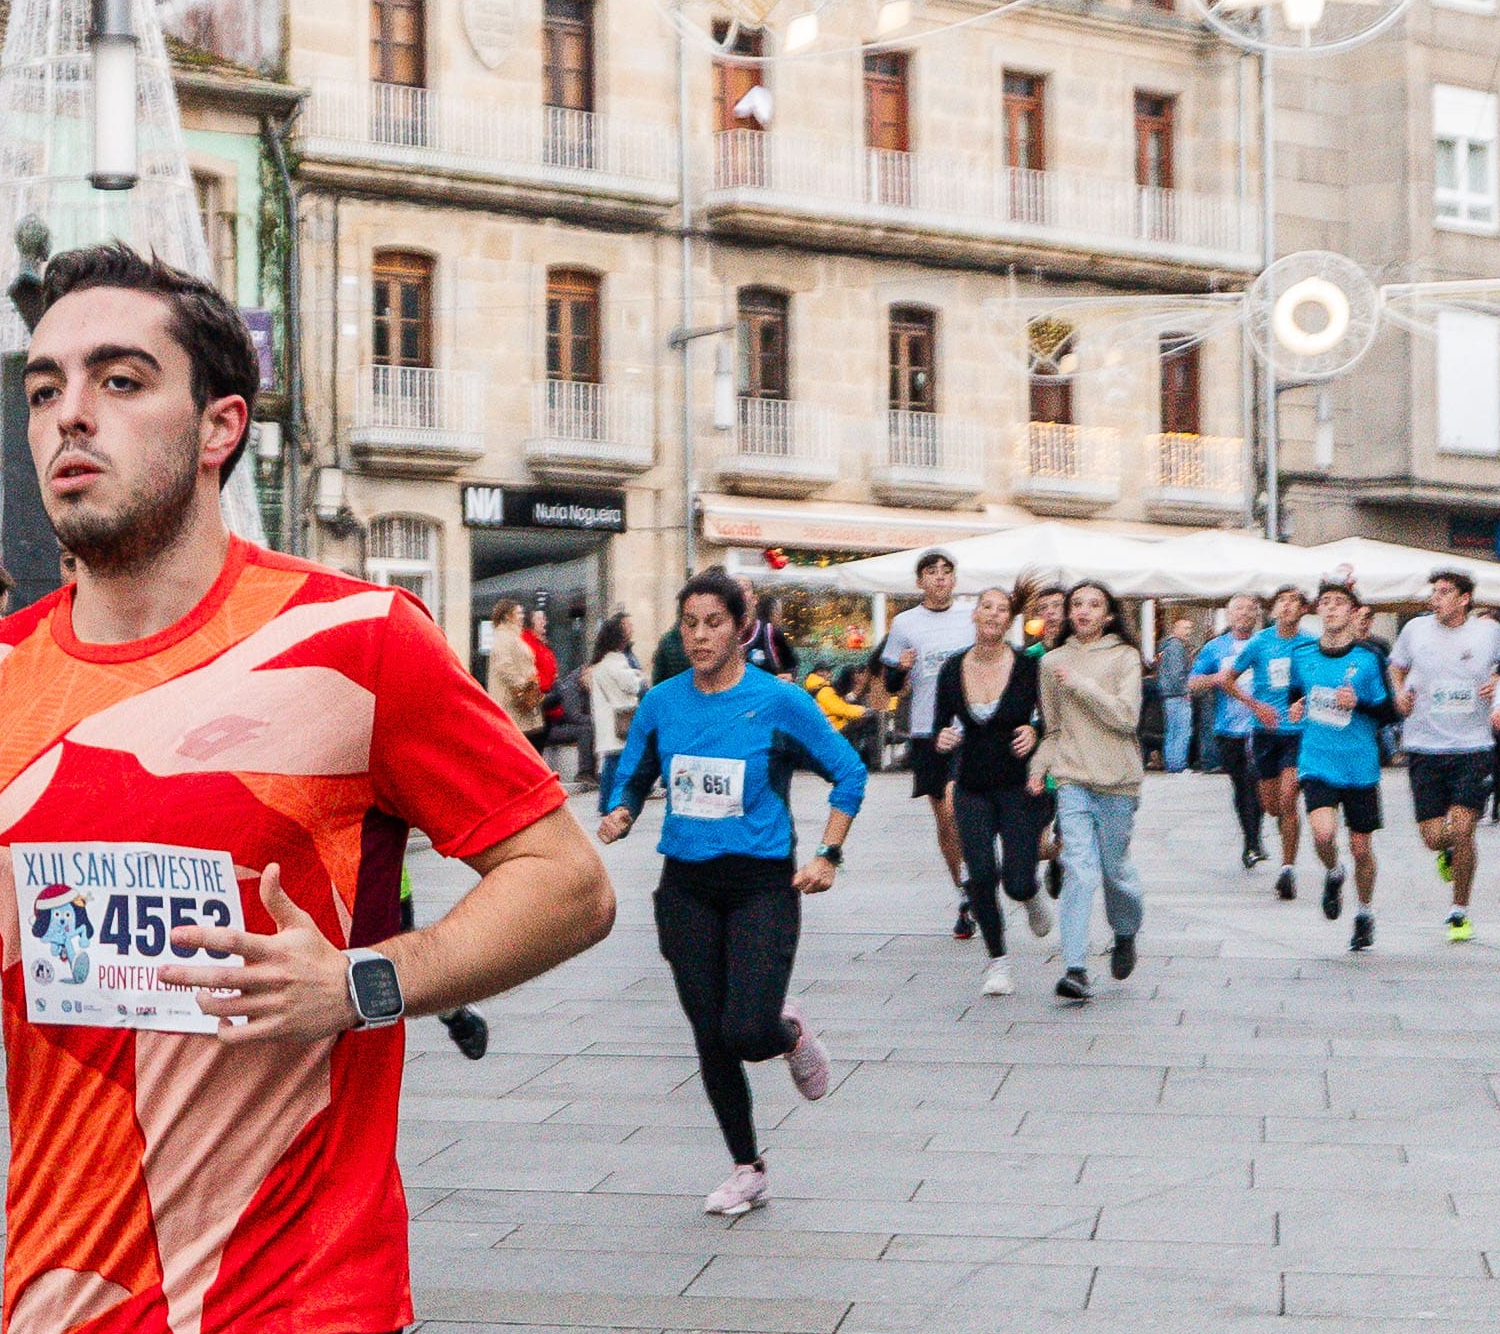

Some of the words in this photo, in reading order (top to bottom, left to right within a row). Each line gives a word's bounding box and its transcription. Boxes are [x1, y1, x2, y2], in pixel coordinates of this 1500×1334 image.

[534, 503, 567, 521] Nuria
[568, 504, 622, 526] Nogueira
[703, 774, 731, 796] 651
[23, 852, 66, 886] XLII
[72, 852, 118, 887] SAN
[123, 852, 227, 894] SILVESTRE
[99, 894, 233, 960] 4553
[98, 965, 194, 992] PONTEV
